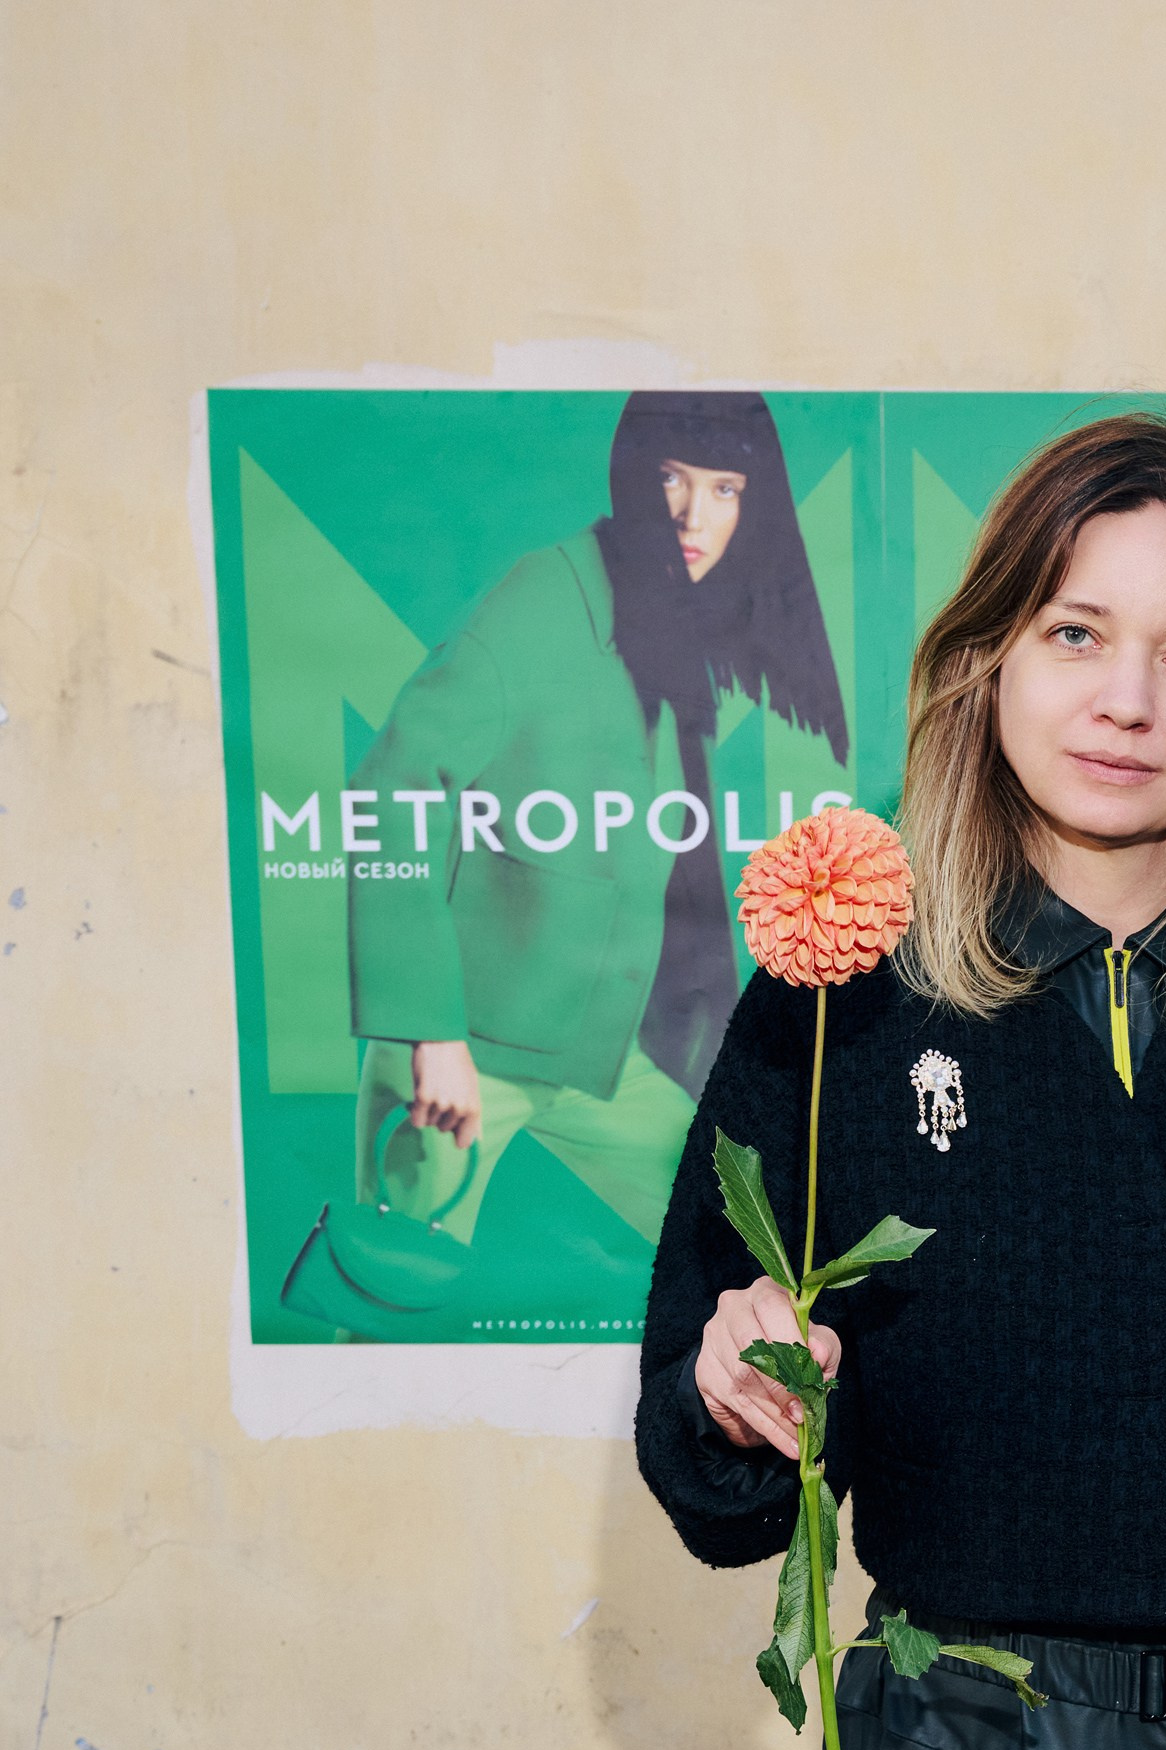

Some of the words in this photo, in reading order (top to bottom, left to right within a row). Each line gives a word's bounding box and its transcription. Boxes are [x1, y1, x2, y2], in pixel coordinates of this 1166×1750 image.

[264, 857, 346, 880] НОВЫЙ
[353, 861, 430, 880] СЕЗОН
[472, 1319, 647, 1330] METROPOLIS.MOSC
